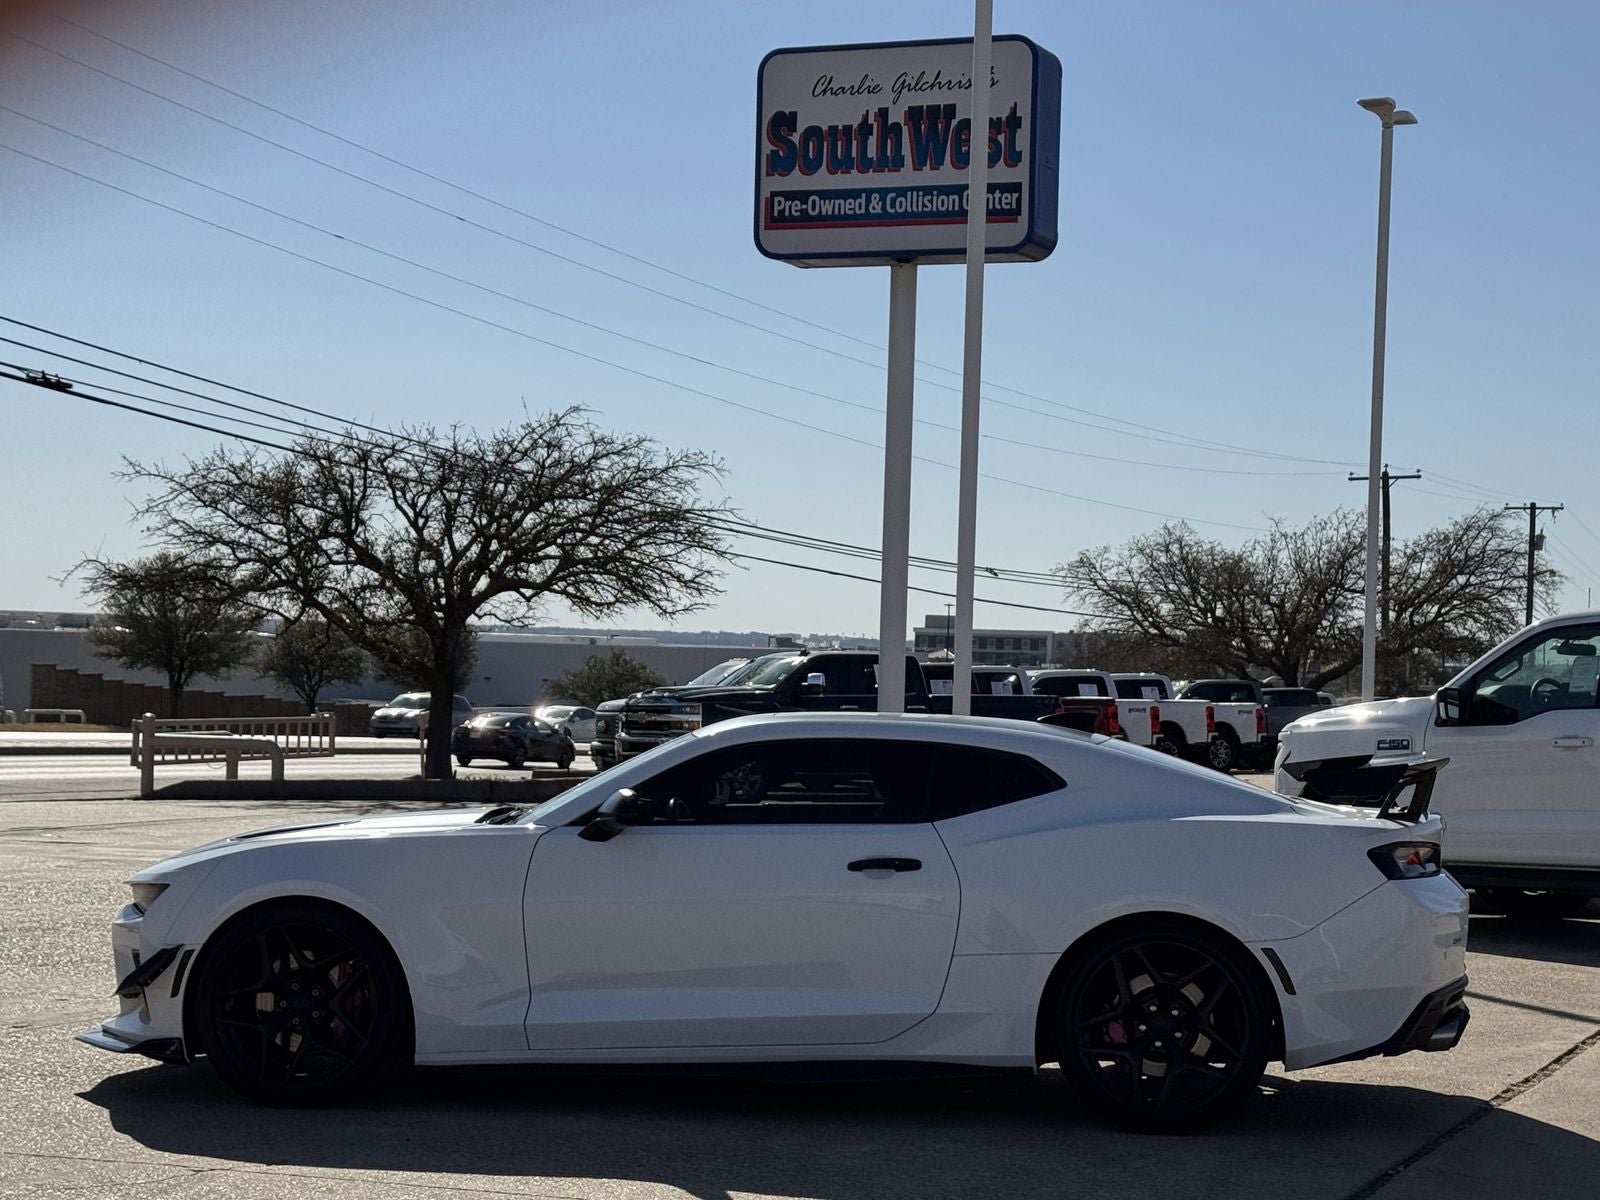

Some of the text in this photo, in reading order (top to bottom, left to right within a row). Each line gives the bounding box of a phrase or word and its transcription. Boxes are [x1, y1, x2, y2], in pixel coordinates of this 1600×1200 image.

[811, 65, 1000, 105] Charlie Gilchris's
[773, 189, 1020, 217] Pre-Owned & Collision Cnter
